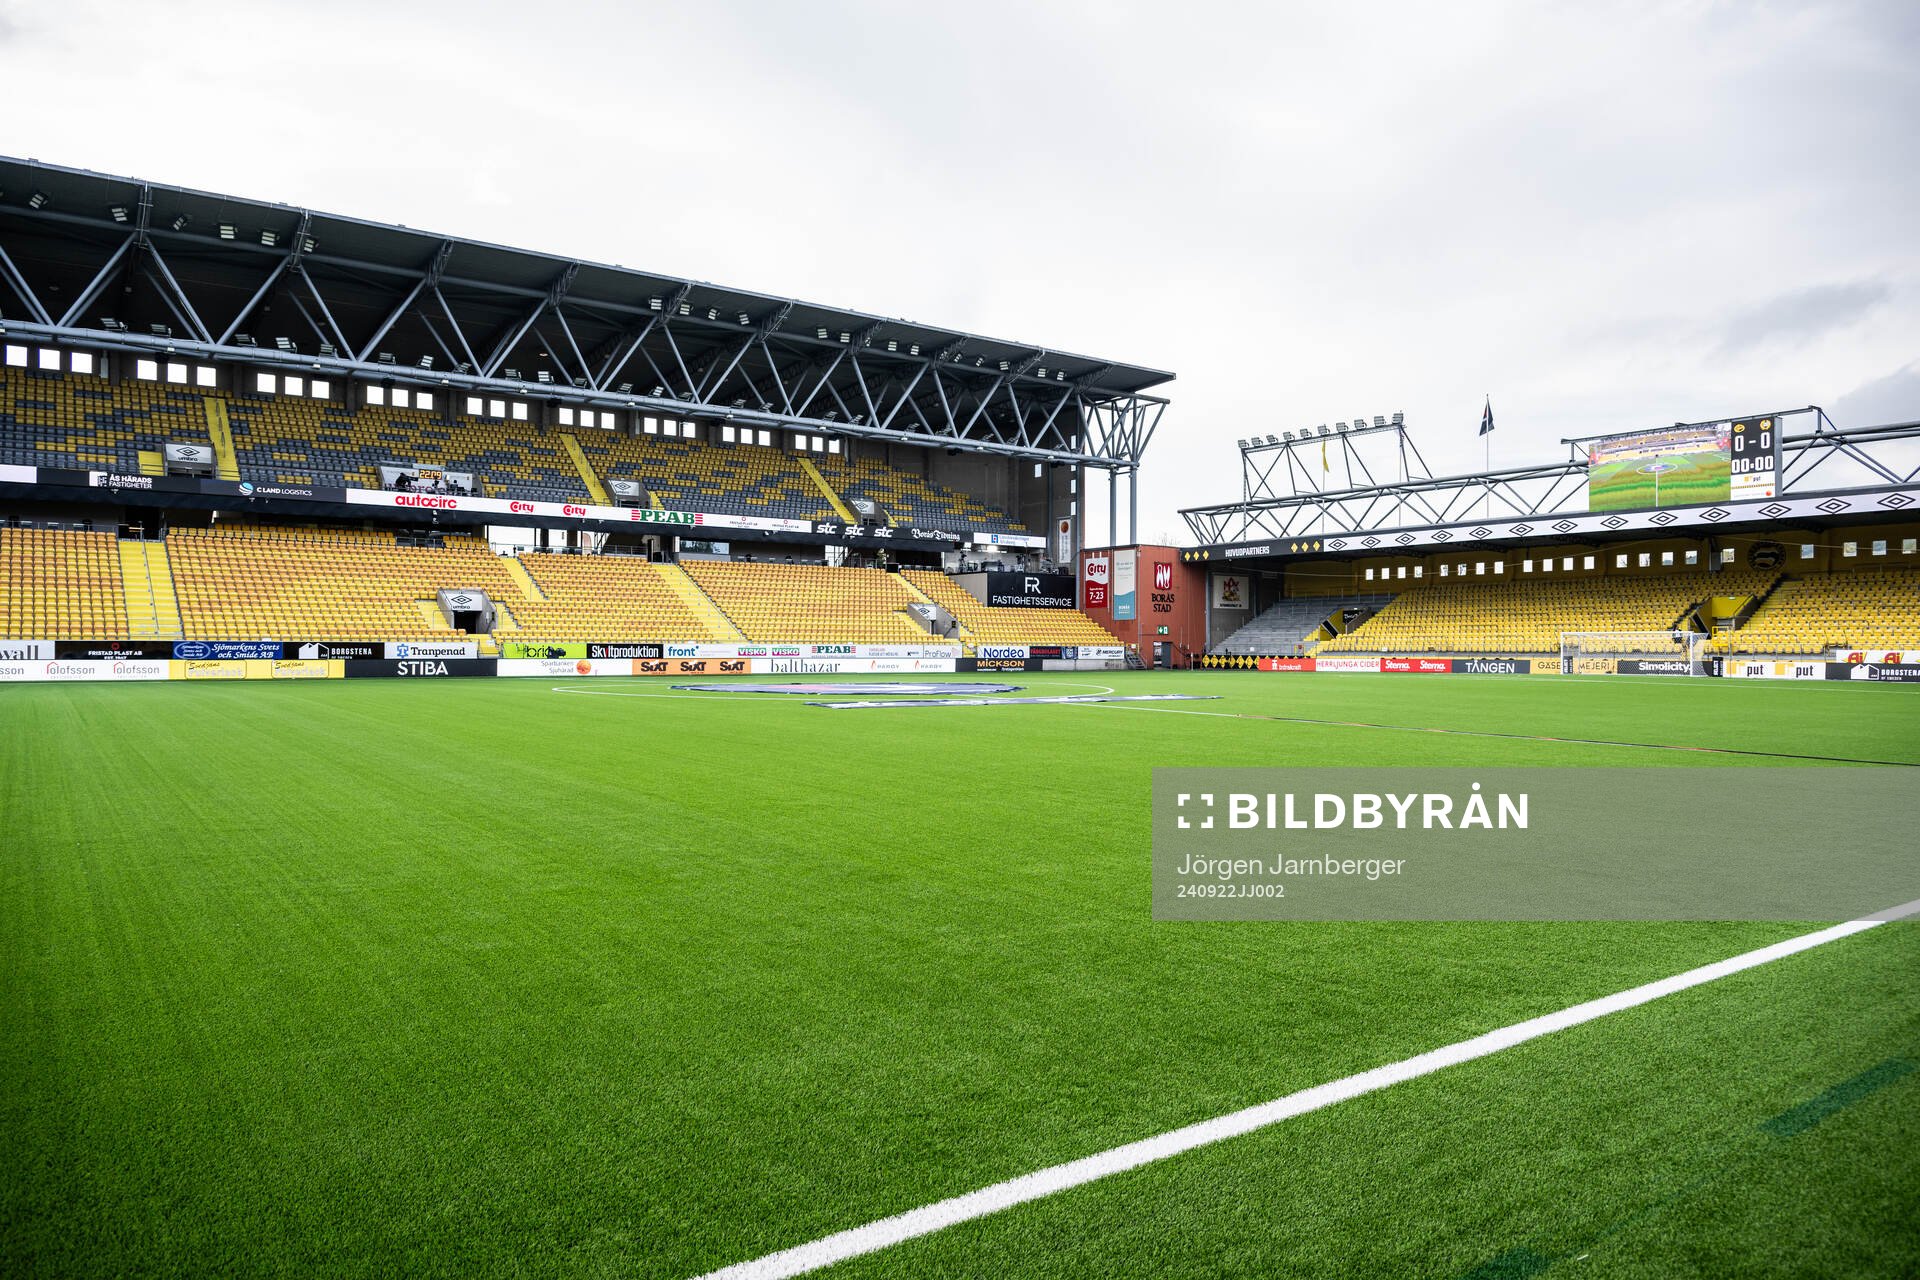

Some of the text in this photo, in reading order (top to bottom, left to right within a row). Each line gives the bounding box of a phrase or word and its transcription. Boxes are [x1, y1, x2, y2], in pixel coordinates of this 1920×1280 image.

[1735, 435, 1744, 451] 0
[1761, 432, 1770, 448] 0
[121, 474, 152, 484] HÄRADS
[108, 481, 153, 489] FASTIGHETER
[281, 488, 312, 497] LOGISTICS
[395, 494, 457, 509] autocirc
[640, 510, 696, 525] PEAB
[816, 522, 837, 534] stc
[844, 525, 865, 537] stc
[873, 526, 894, 538] stc
[1225, 545, 1270, 558] HUVUDPARTNERS
[992, 595, 1072, 607] FASTIGHETSSERVICE
[1152, 592, 1175, 603] BORÅS
[1153, 603, 1171, 613] STAD
[217, 651, 274, 660] och Smide AB
[331, 647, 372, 655] BORGSTENA
[411, 647, 466, 658] Tranpenad
[668, 646, 696, 657] front
[738, 648, 767, 656] VISKO
[772, 648, 800, 656] VISKO
[816, 646, 852, 654] PEAB
[983, 647, 1025, 658] Nordea
[49, 665, 95, 675] olofsson
[116, 664, 160, 675] olofsson
[397, 661, 449, 676] STIBA
[770, 658, 841, 674] balthazar
[1465, 660, 1515, 674] TÅNGEN
[1747, 664, 1764, 677] put
[1796, 665, 1814, 678] put
